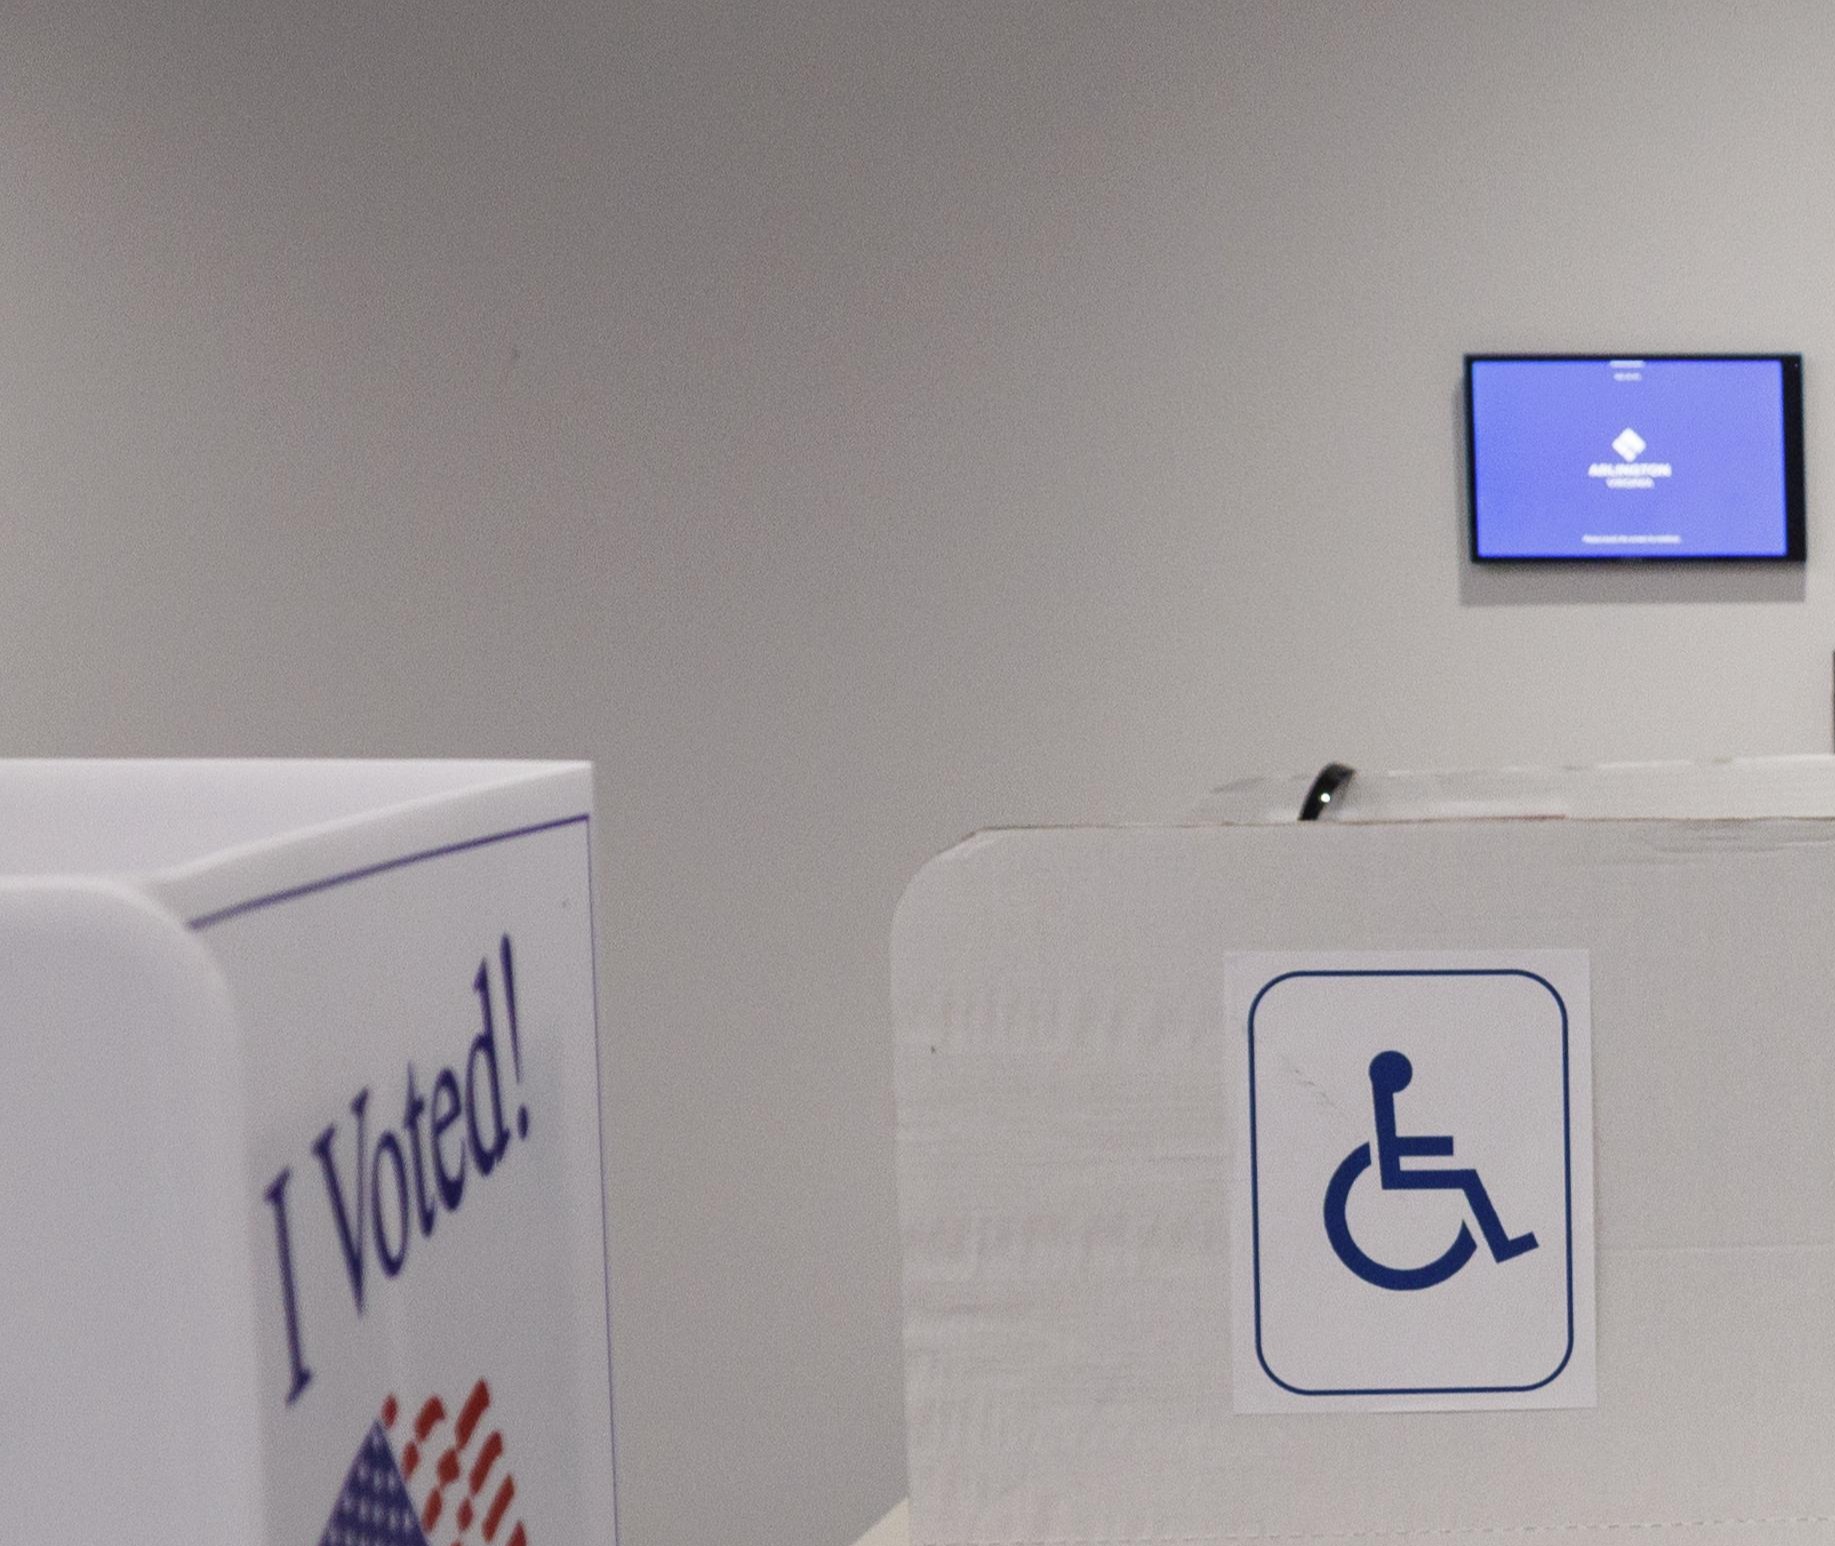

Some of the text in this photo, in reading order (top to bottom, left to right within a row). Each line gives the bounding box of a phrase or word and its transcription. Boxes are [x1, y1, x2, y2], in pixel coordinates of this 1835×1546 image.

[1588, 463, 1672, 478] ARLINGTON
[265, 932, 530, 1407] I Voted!
